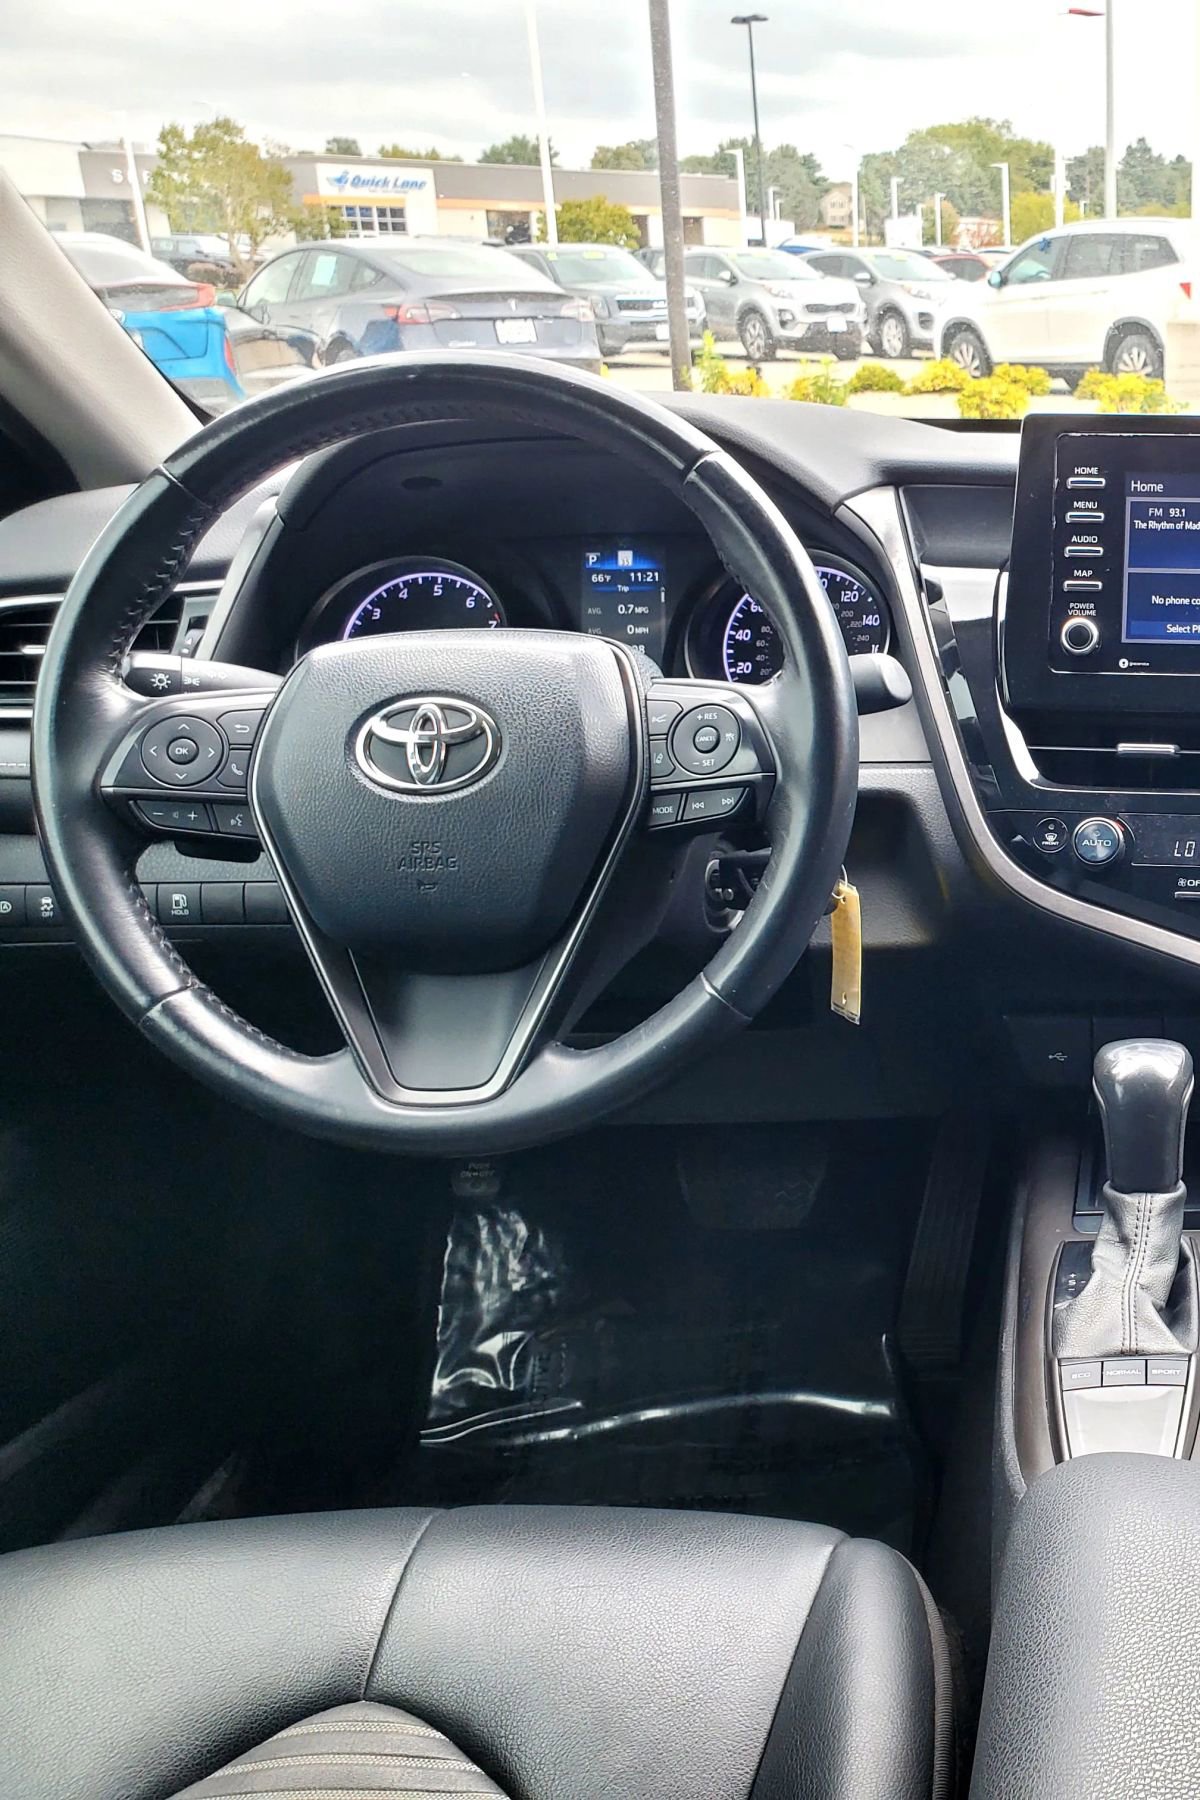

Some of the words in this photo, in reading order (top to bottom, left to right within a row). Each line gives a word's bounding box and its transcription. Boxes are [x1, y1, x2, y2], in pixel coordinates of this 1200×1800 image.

[350, 174, 391, 189] Quick
[392, 176, 427, 191] Lane
[1074, 467, 1099, 475] HOME
[1130, 480, 1164, 493] Home
[1073, 501, 1098, 509] MENU
[1148, 508, 1163, 518] FM
[1169, 508, 1186, 518] 93.1
[1133, 519, 1148, 530] The
[1148, 520, 1175, 532] Rhythm
[1175, 520, 1184, 531] of
[1071, 535, 1098, 544] AUDIO
[588, 555, 598, 566] P
[629, 571, 659, 582] 11:21
[1073, 569, 1094, 578] MAP
[398, 588, 409, 600] 4
[433, 585, 443, 596] 5
[617, 584, 630, 593] Trip
[840, 590, 860, 603] 120
[1151, 595, 1164, 605] No
[1165, 596, 1190, 606] phone
[465, 597, 476, 608] 6
[1069, 602, 1095, 610] POWER
[371, 608, 381, 620] 3
[617, 604, 635, 615] 0.7
[635, 606, 649, 614] MPG
[840, 610, 854, 618] 200
[862, 614, 881, 627] 140
[626, 624, 635, 635] 0
[1166, 624, 1191, 634] Select
[734, 629, 751, 641] 40
[755, 654, 766, 662] 40
[736, 662, 752, 673] 20
[175, 747, 189, 755] OK
[702, 759, 716, 767] SET
[652, 806, 674, 814] MODE
[410, 840, 442, 856] SRS
[1082, 839, 1112, 847] AUTO
[1174, 840, 1196, 858] LO
[397, 856, 459, 872] AIRBAG
[171, 908, 189, 916] HOLD
[1106, 1368, 1142, 1376] NORMAL
